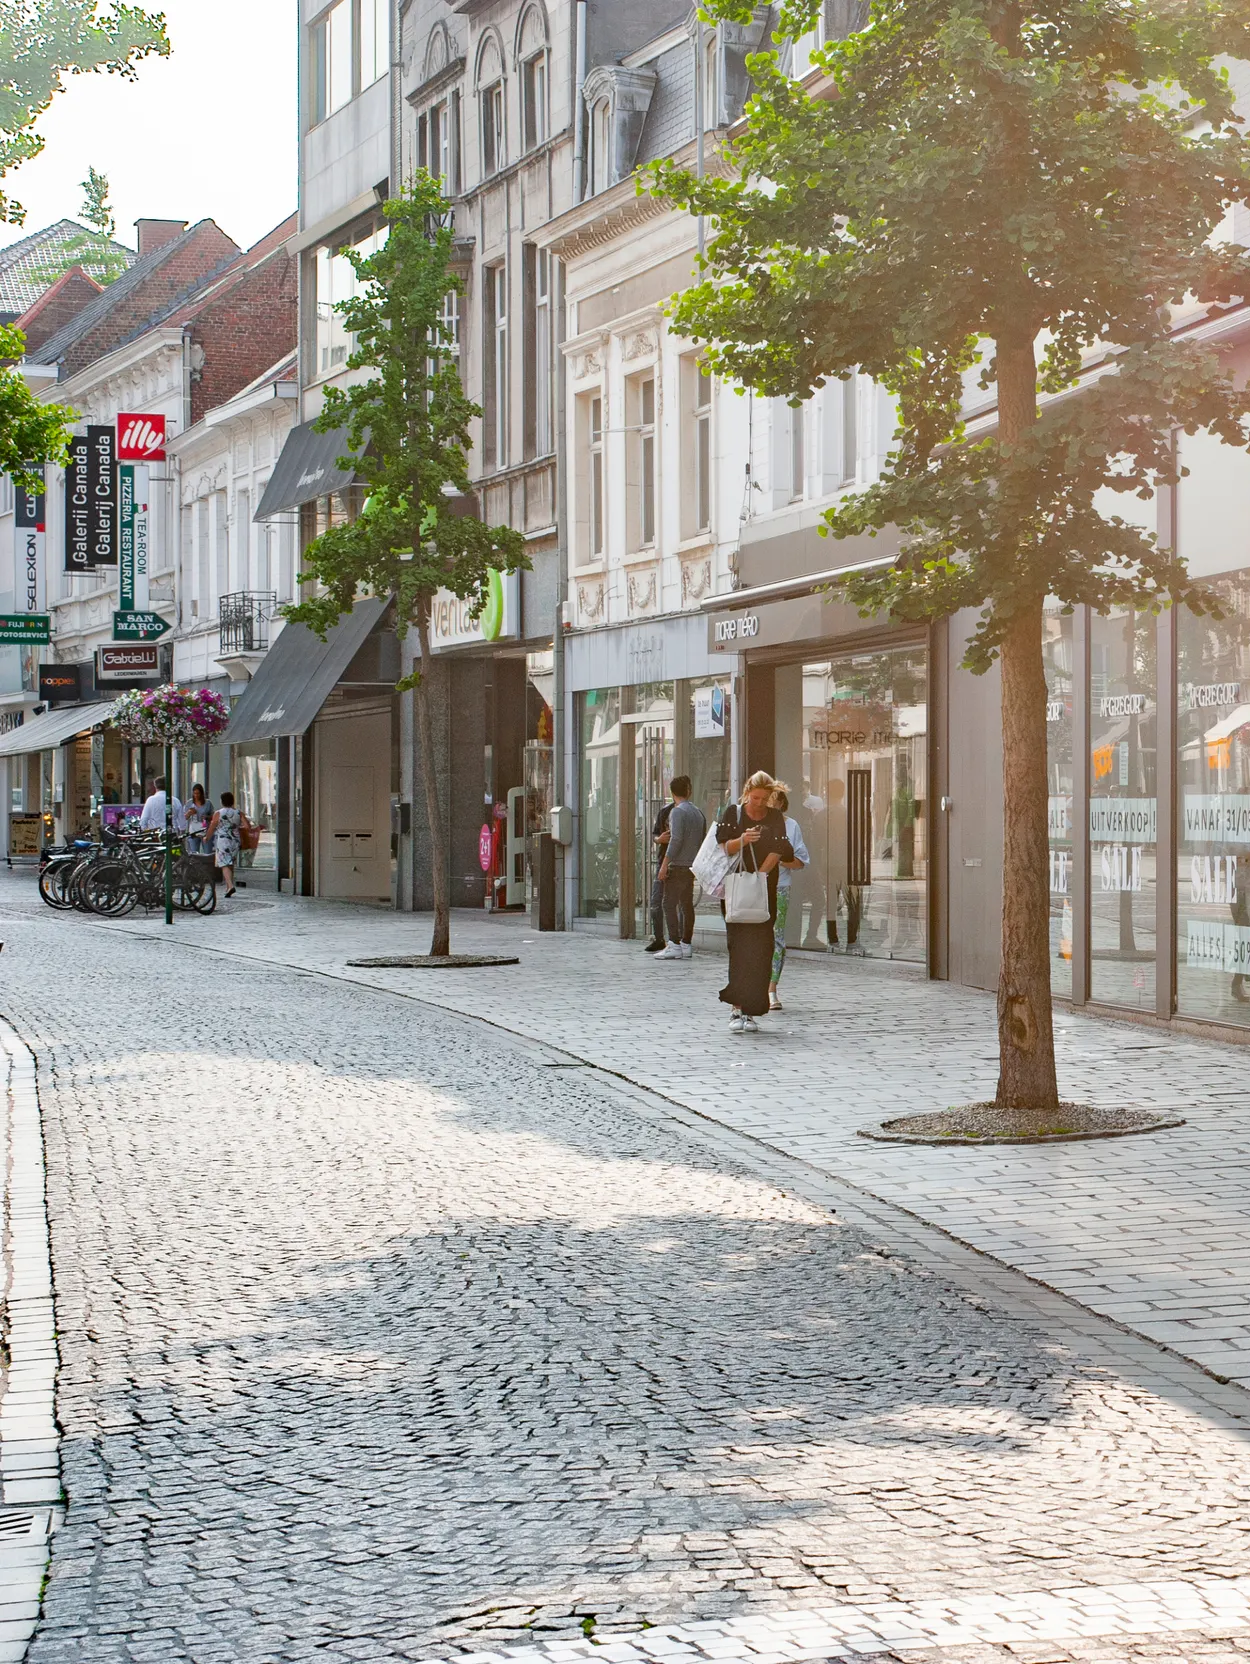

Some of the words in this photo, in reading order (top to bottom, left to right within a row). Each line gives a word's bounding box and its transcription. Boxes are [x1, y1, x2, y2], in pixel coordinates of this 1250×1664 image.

[120, 419, 164, 456] illy
[72, 444, 89, 504] Canada
[95, 434, 111, 497] Canada
[122, 475, 133, 523] PIZZERIA
[95, 501, 114, 556] Galerij
[136, 517, 148, 576] TEA-ROOM
[121, 527, 133, 600] RESTAURANT
[117, 623, 164, 631] MARCO
[126, 614, 154, 623] SAN
[1048, 809, 1065, 830] ALE
[1091, 809, 1149, 833] UITVERKOOP
[1186, 808, 1221, 832] VANAF
[1100, 845, 1142, 892] SALE
[1189, 854, 1239, 904] SALE
[1188, 934, 1222, 960] ALLES
